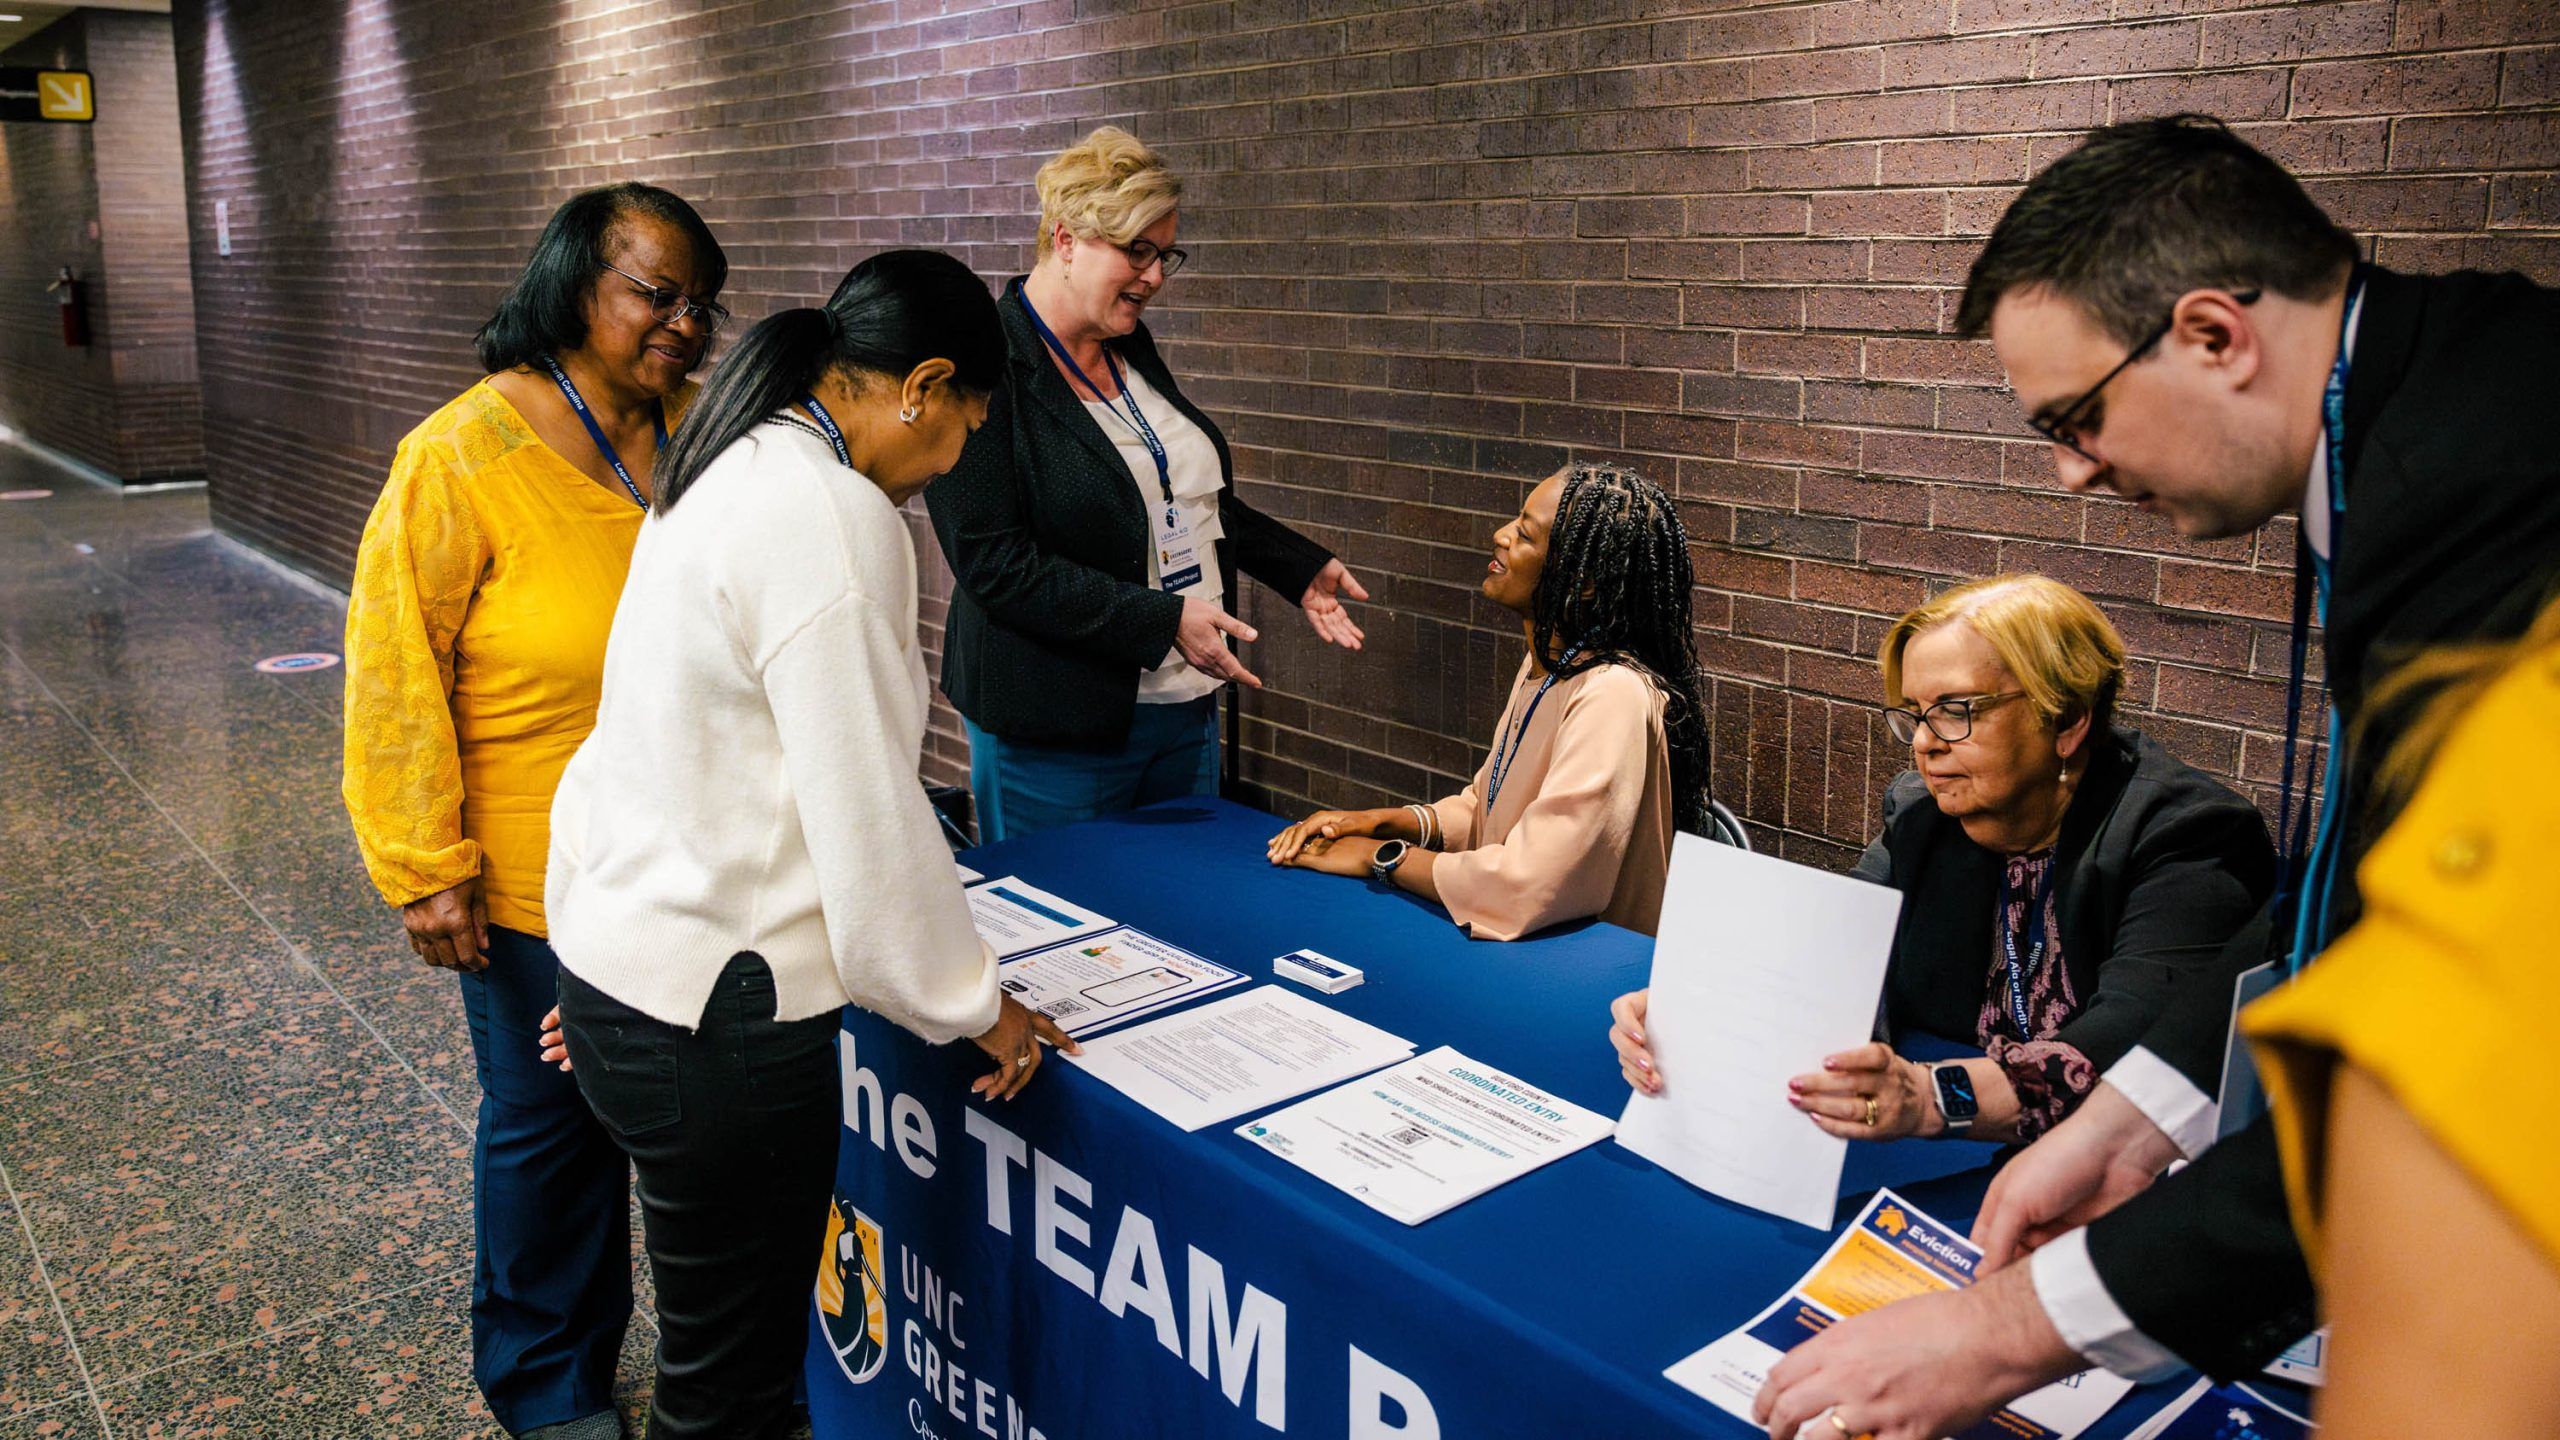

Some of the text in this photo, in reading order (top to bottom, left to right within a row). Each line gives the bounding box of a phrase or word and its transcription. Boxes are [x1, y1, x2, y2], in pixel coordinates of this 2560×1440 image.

[562, 379, 584, 411] Carolina
[808, 400, 839, 438] Carolina
[615, 462, 631, 485] Legal
[2006, 931, 2018, 960] Legal
[2014, 994, 2028, 1025] North
[1430, 1082, 1458, 1098] SHOULD
[1455, 1093, 1486, 1111] CONTACT
[1485, 1106, 1534, 1134] COORDINATED
[1531, 1129, 1562, 1144] ENTRY?
[1449, 1067, 1568, 1123] COORDINATED ENTRY
[1491, 1074, 1550, 1104] GUILFORD COUNTY
[1414, 1109, 1442, 1126] ACCESS
[840, 1028, 937, 1179] he
[965, 1105, 1286, 1432] TEAM
[1907, 1224, 1973, 1271] Eviction
[901, 1244, 966, 1350] UNC
[904, 1318, 1046, 1440] GREEN
